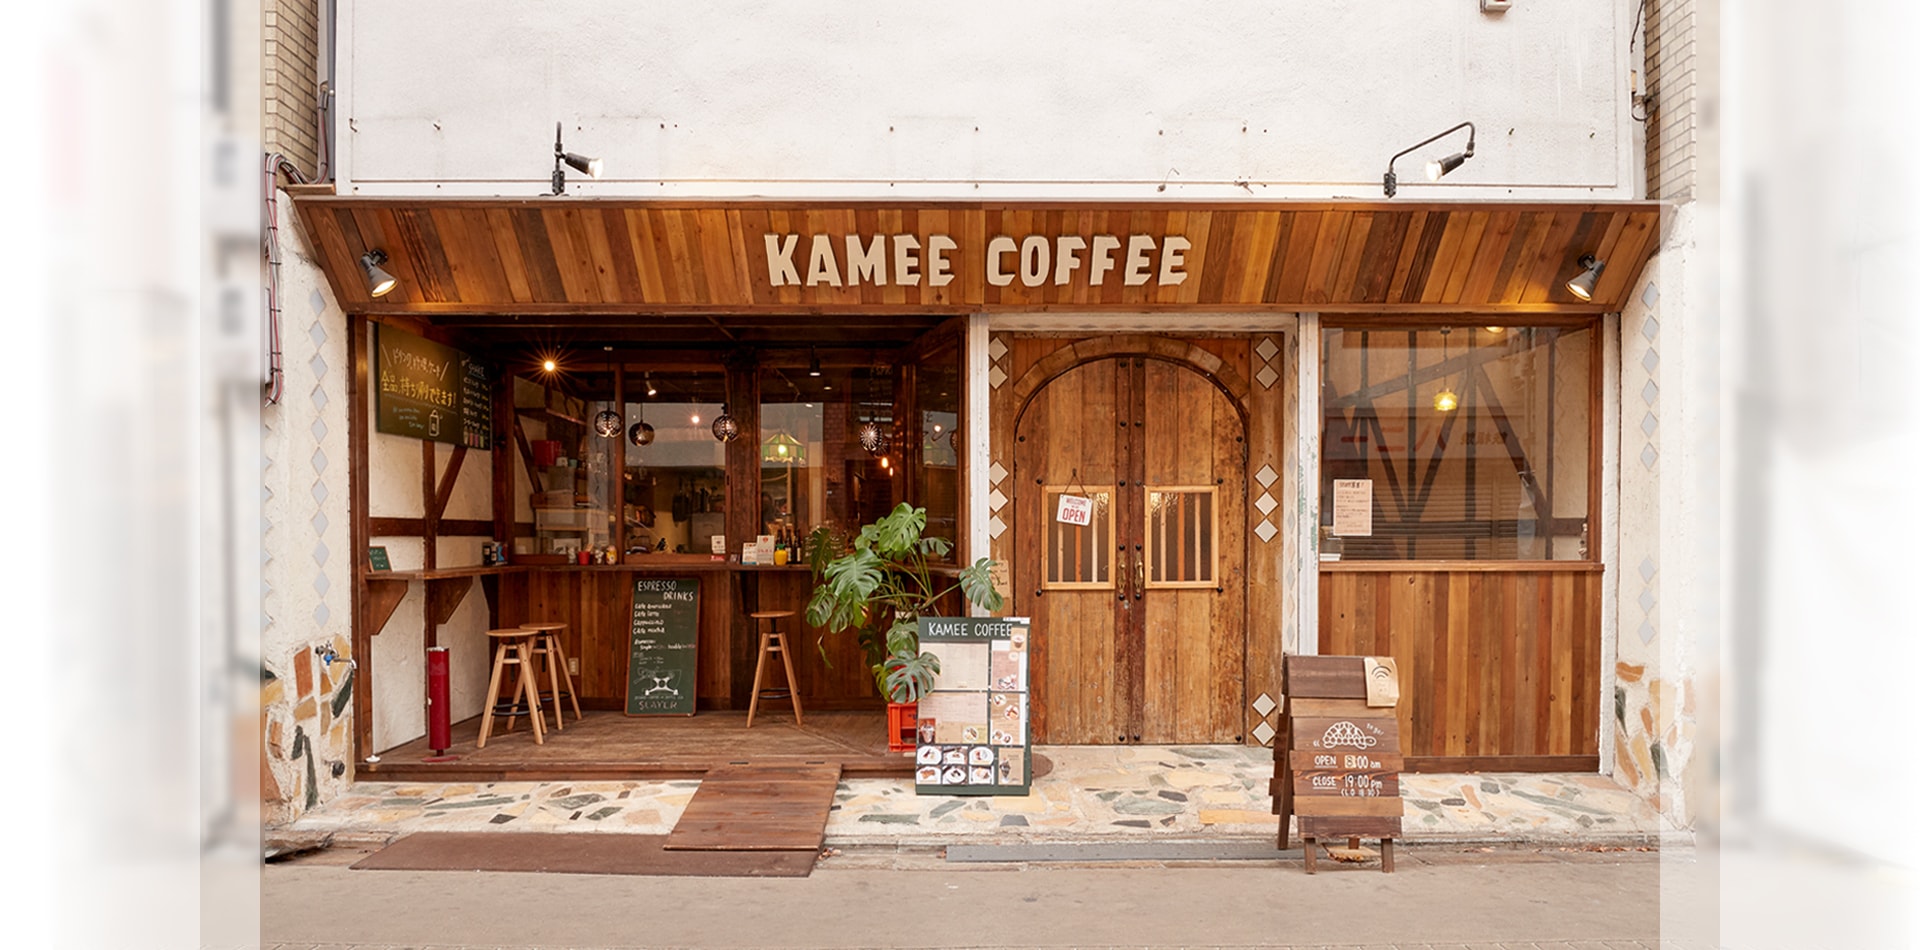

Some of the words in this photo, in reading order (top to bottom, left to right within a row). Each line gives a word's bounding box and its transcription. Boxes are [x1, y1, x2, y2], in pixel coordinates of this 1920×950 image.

[764, 233, 958, 287] KAMEE
[986, 235, 1192, 287] COFFEE
[1062, 508, 1086, 523] OPEN
[638, 580, 677, 592] ESPRESSO
[663, 591, 694, 601] DRINKS
[928, 622, 968, 636] KAMEE
[974, 623, 1012, 637] COFFEE
[1314, 755, 1337, 766] OPEN
[1370, 760, 1381, 769] am
[1312, 775, 1336, 786] CLOSE
[1344, 774, 1369, 788] 19:00
[1370, 780, 1382, 789] pm
